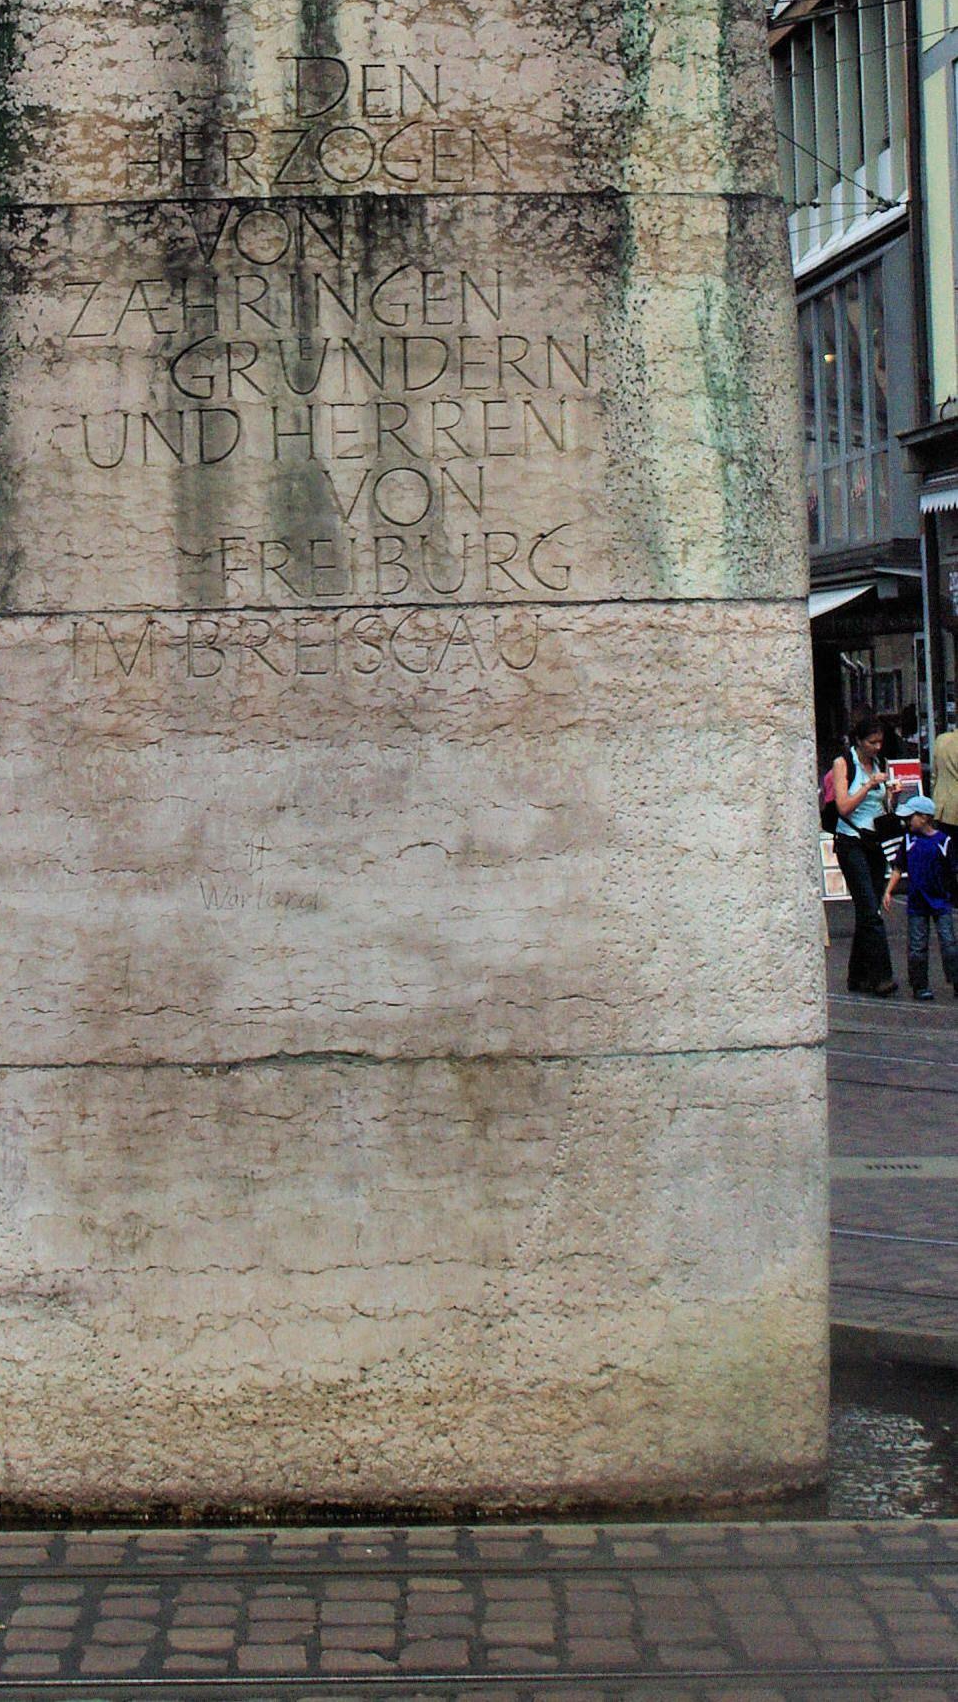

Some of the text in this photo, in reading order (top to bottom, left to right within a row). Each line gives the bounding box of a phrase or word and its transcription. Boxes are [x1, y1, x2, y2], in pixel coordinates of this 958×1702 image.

[277, 55, 442, 118] DEN
[123, 120, 514, 188] HERZOGEN
[187, 203, 345, 266] VON
[80, 399, 568, 470] UND HERREN
[321, 465, 485, 527] VON
[219, 522, 572, 599] FREIBURG
[71, 609, 543, 679] IM BREISGAU
